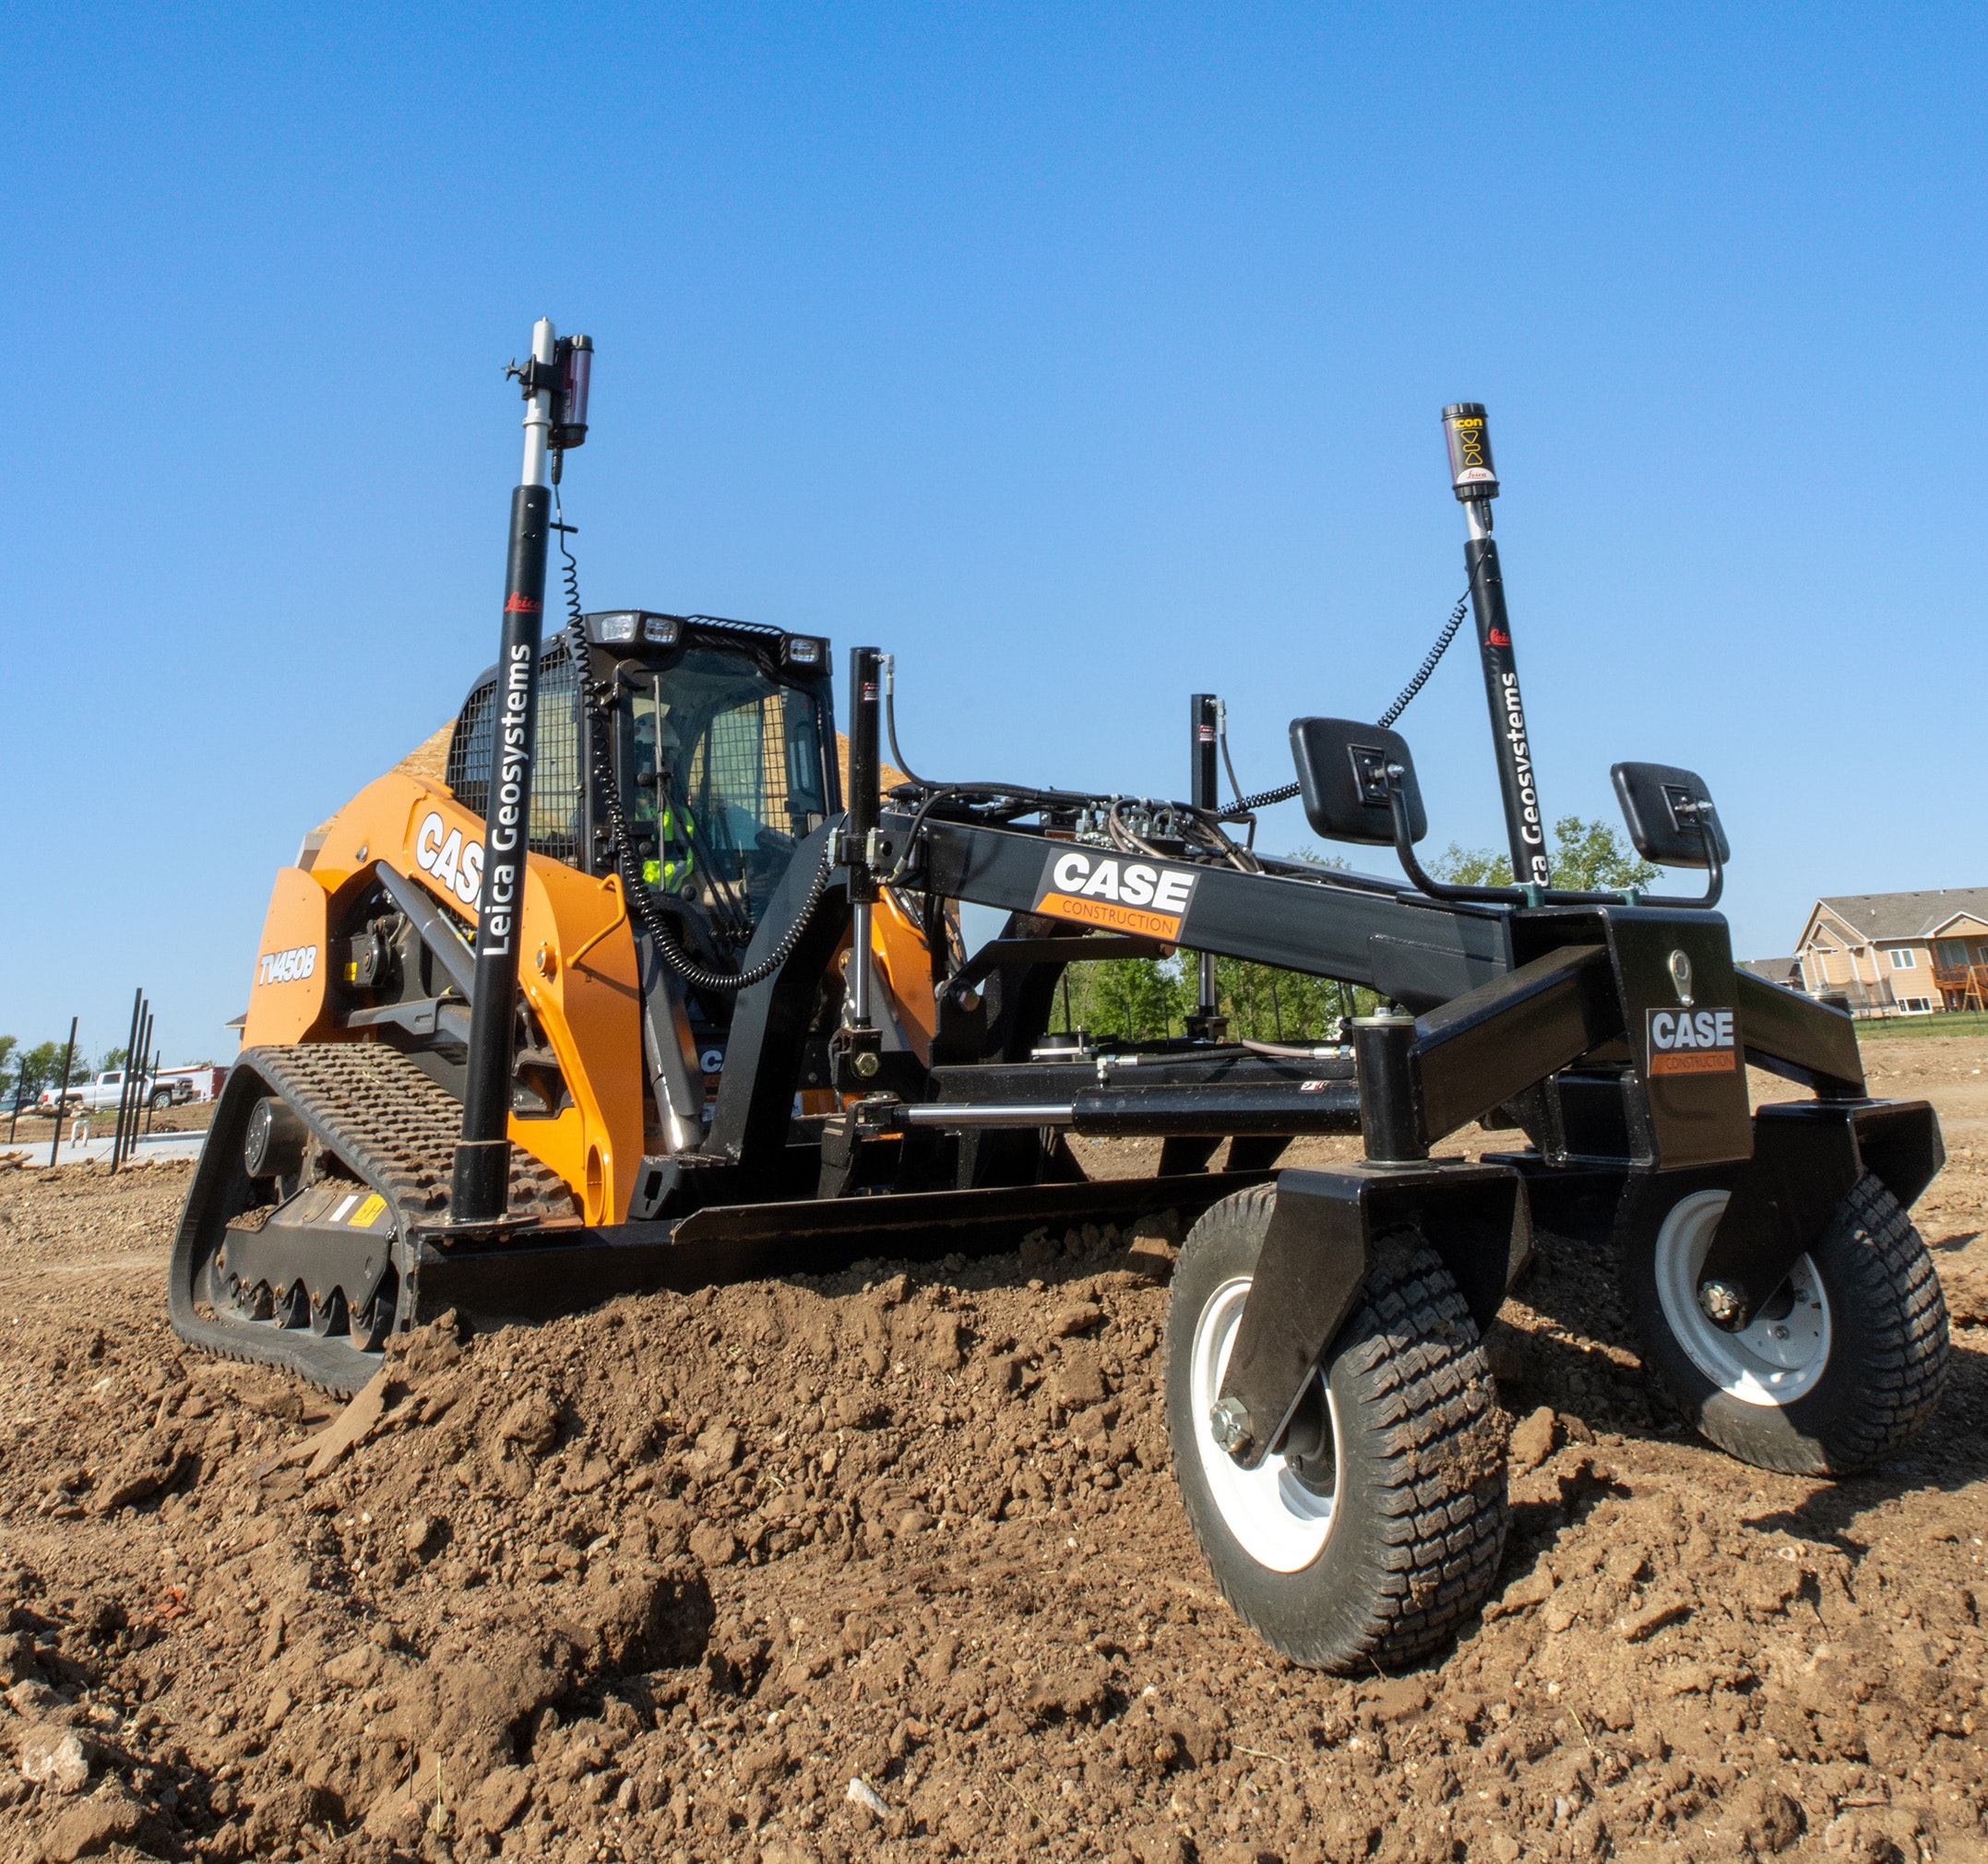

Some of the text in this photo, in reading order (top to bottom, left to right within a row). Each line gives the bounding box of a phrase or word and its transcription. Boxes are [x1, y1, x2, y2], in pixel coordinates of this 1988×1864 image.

[1502, 671, 1543, 845] Geosystems
[482, 644, 530, 956] Leica Geosystems
[417, 812, 485, 914] CAS
[1053, 852, 1196, 913] CASE
[1062, 899, 1173, 934] CONSTRUCTION
[259, 945, 317, 986] TV450B
[1652, 1011, 1734, 1050] CASE
[1666, 1054, 1734, 1070] CONSTRUCTION
